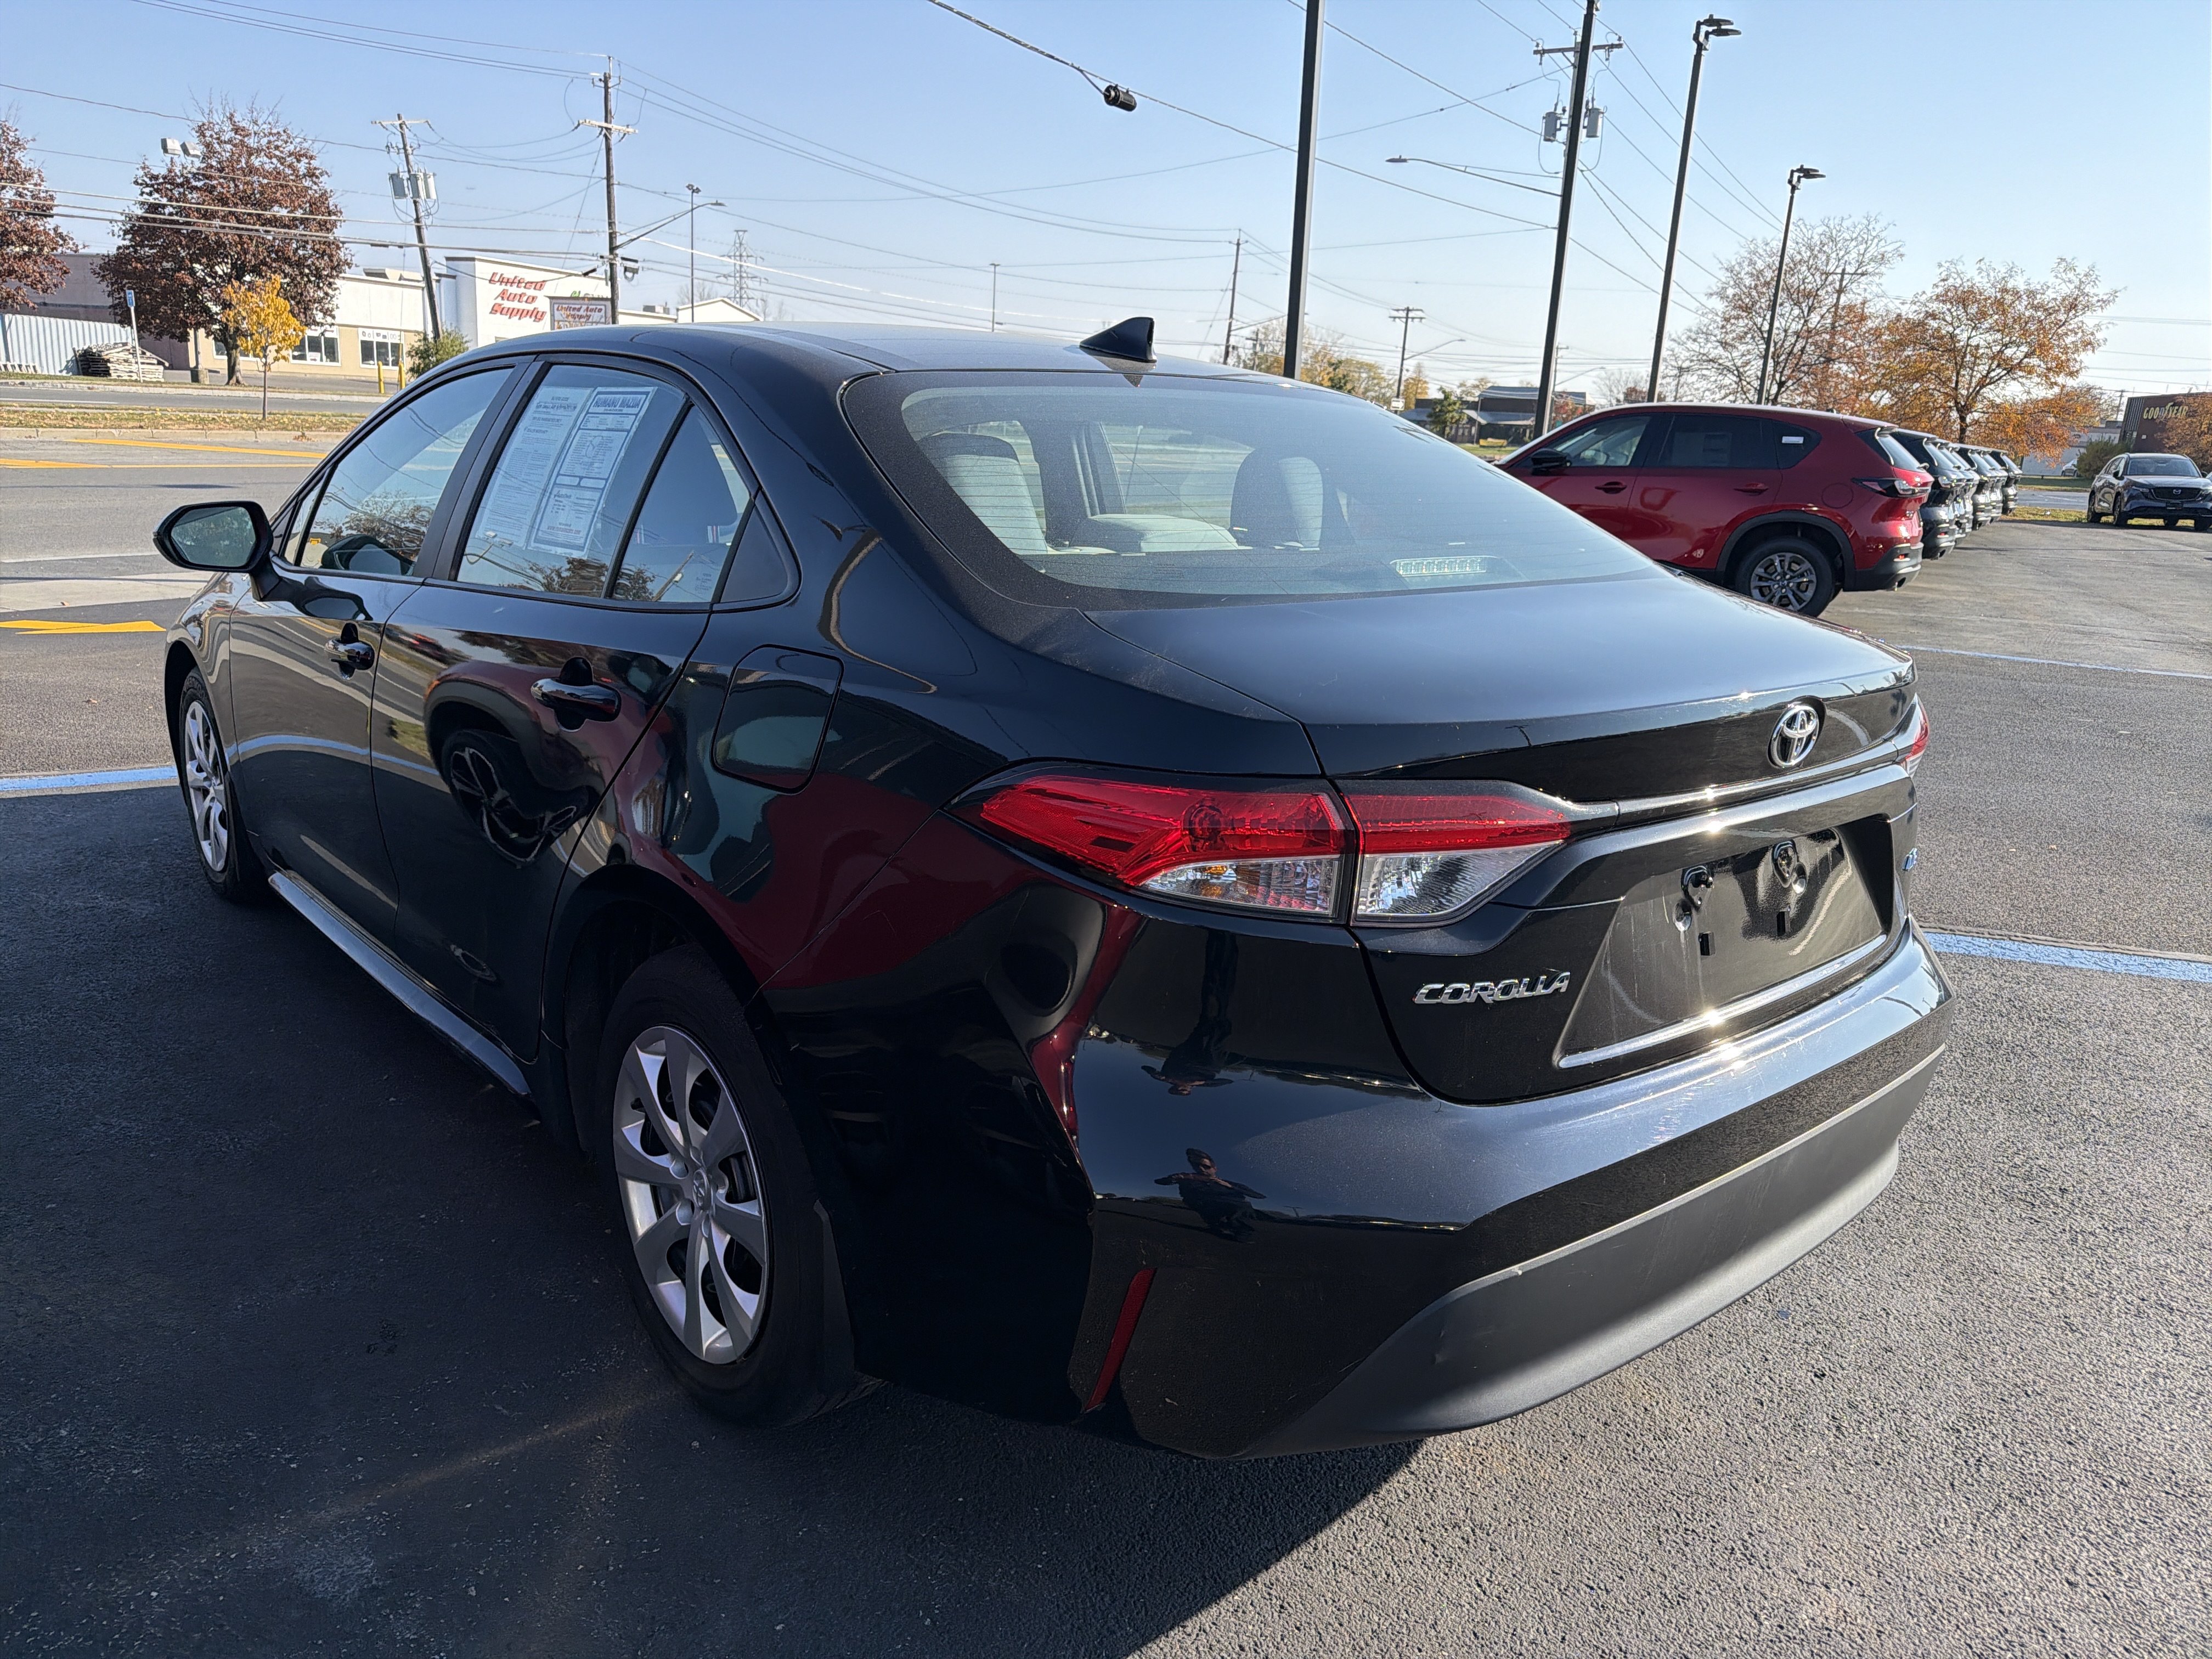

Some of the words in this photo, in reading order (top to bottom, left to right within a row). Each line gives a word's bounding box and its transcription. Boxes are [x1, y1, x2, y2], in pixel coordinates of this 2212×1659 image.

[489, 272, 547, 291] United
[494, 289, 538, 304] Auto
[489, 303, 547, 322] Supply
[556, 304, 582, 313] United
[618, 396, 641, 408] MAZDA
[2143, 402, 2188, 420] GOODYEAR
[1412, 972, 1570, 1004] COROLLA
